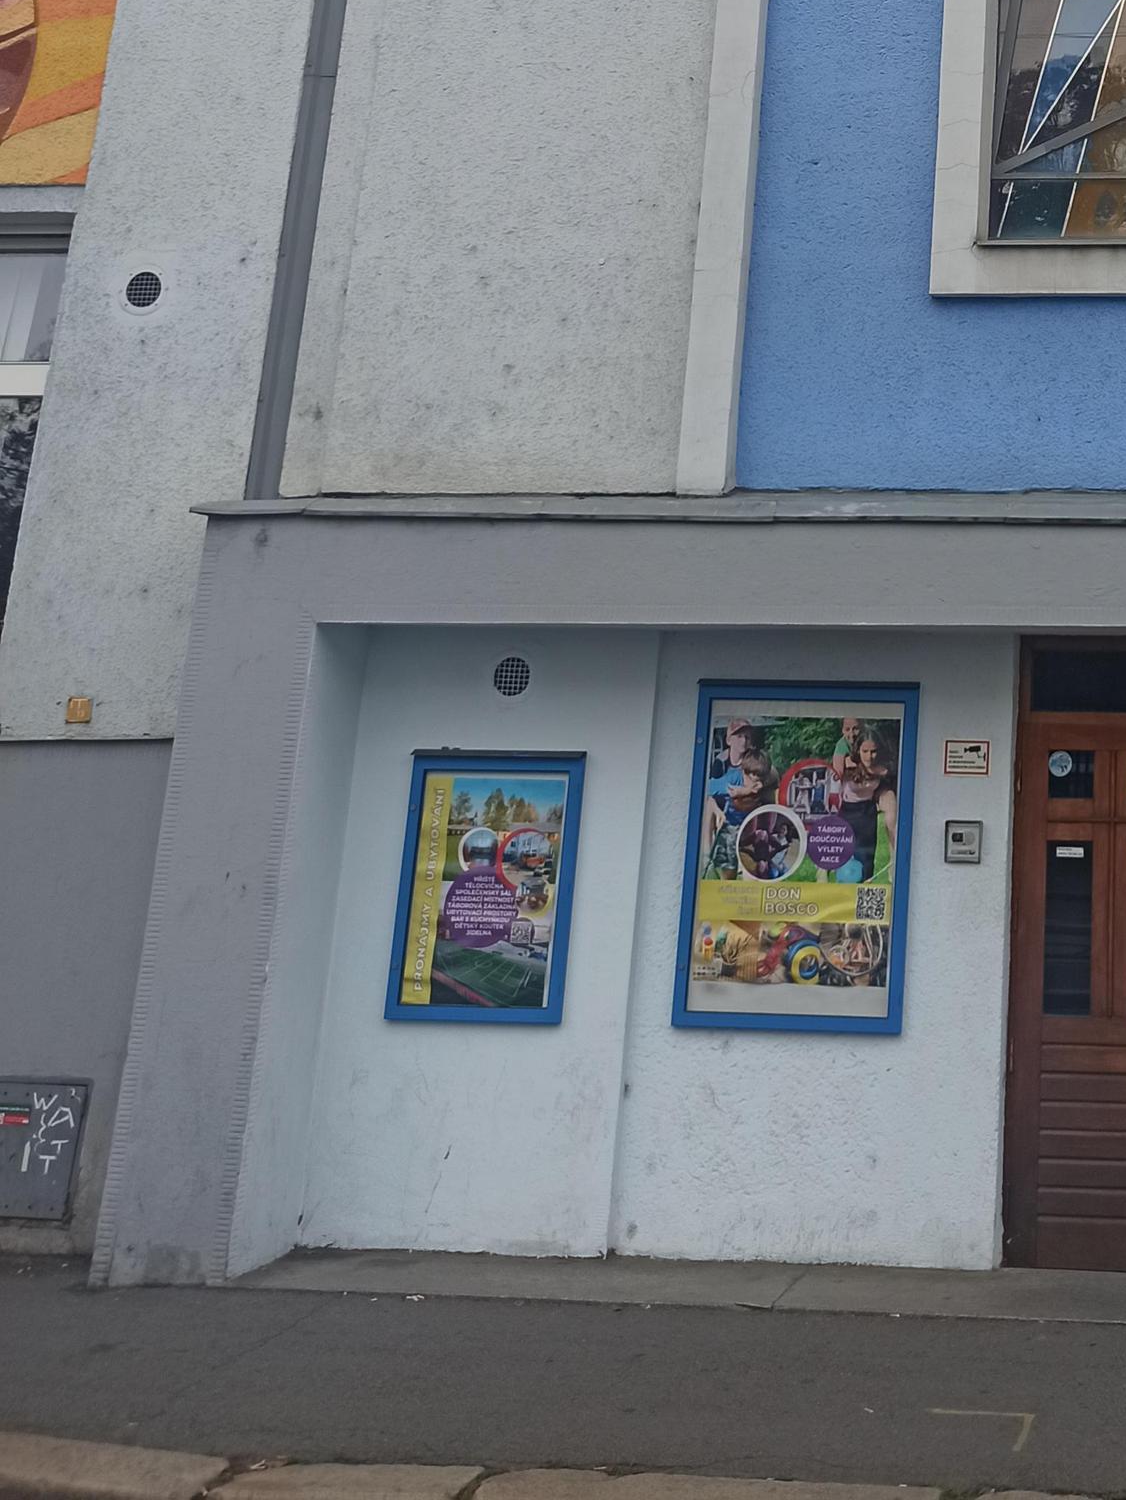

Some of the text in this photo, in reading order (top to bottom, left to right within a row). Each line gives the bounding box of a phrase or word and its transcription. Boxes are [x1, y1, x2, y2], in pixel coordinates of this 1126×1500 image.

[809, 835, 853, 843] DOUČOVÁNÍ
[818, 845, 844, 853] VÝLETY
[820, 855, 840, 863] AKCE
[766, 887, 801, 900] DON
[764, 902, 818, 915] BOSCO
[414, 904, 431, 990] PRONÁJMY
[424, 886, 433, 896] A
